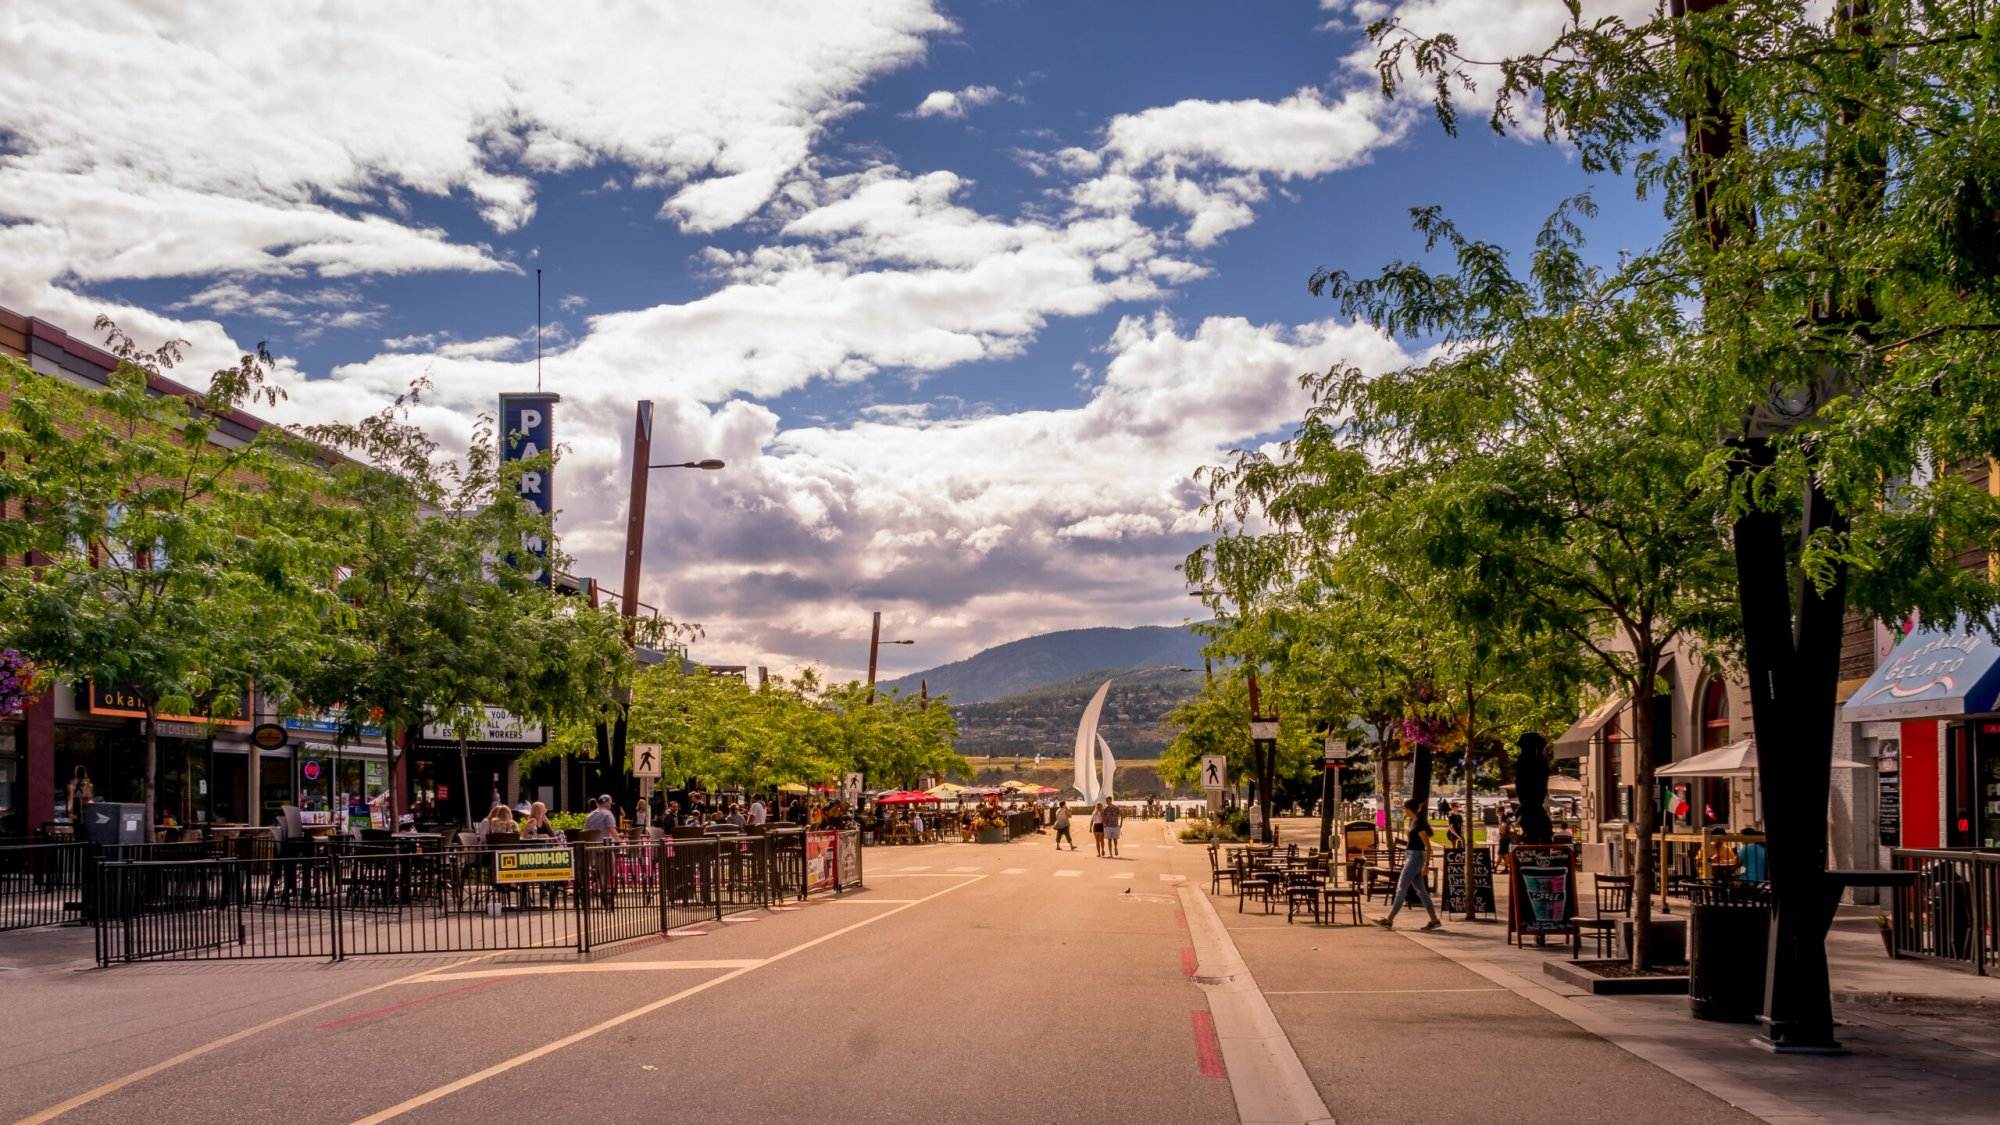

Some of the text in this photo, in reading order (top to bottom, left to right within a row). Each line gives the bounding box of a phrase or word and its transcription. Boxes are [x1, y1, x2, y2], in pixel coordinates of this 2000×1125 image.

[1884, 658, 1965, 681] GELATO
[487, 720, 500, 729] ALL
[489, 730, 524, 739] WORKERS
[519, 851, 569, 865] MODU-LOC
